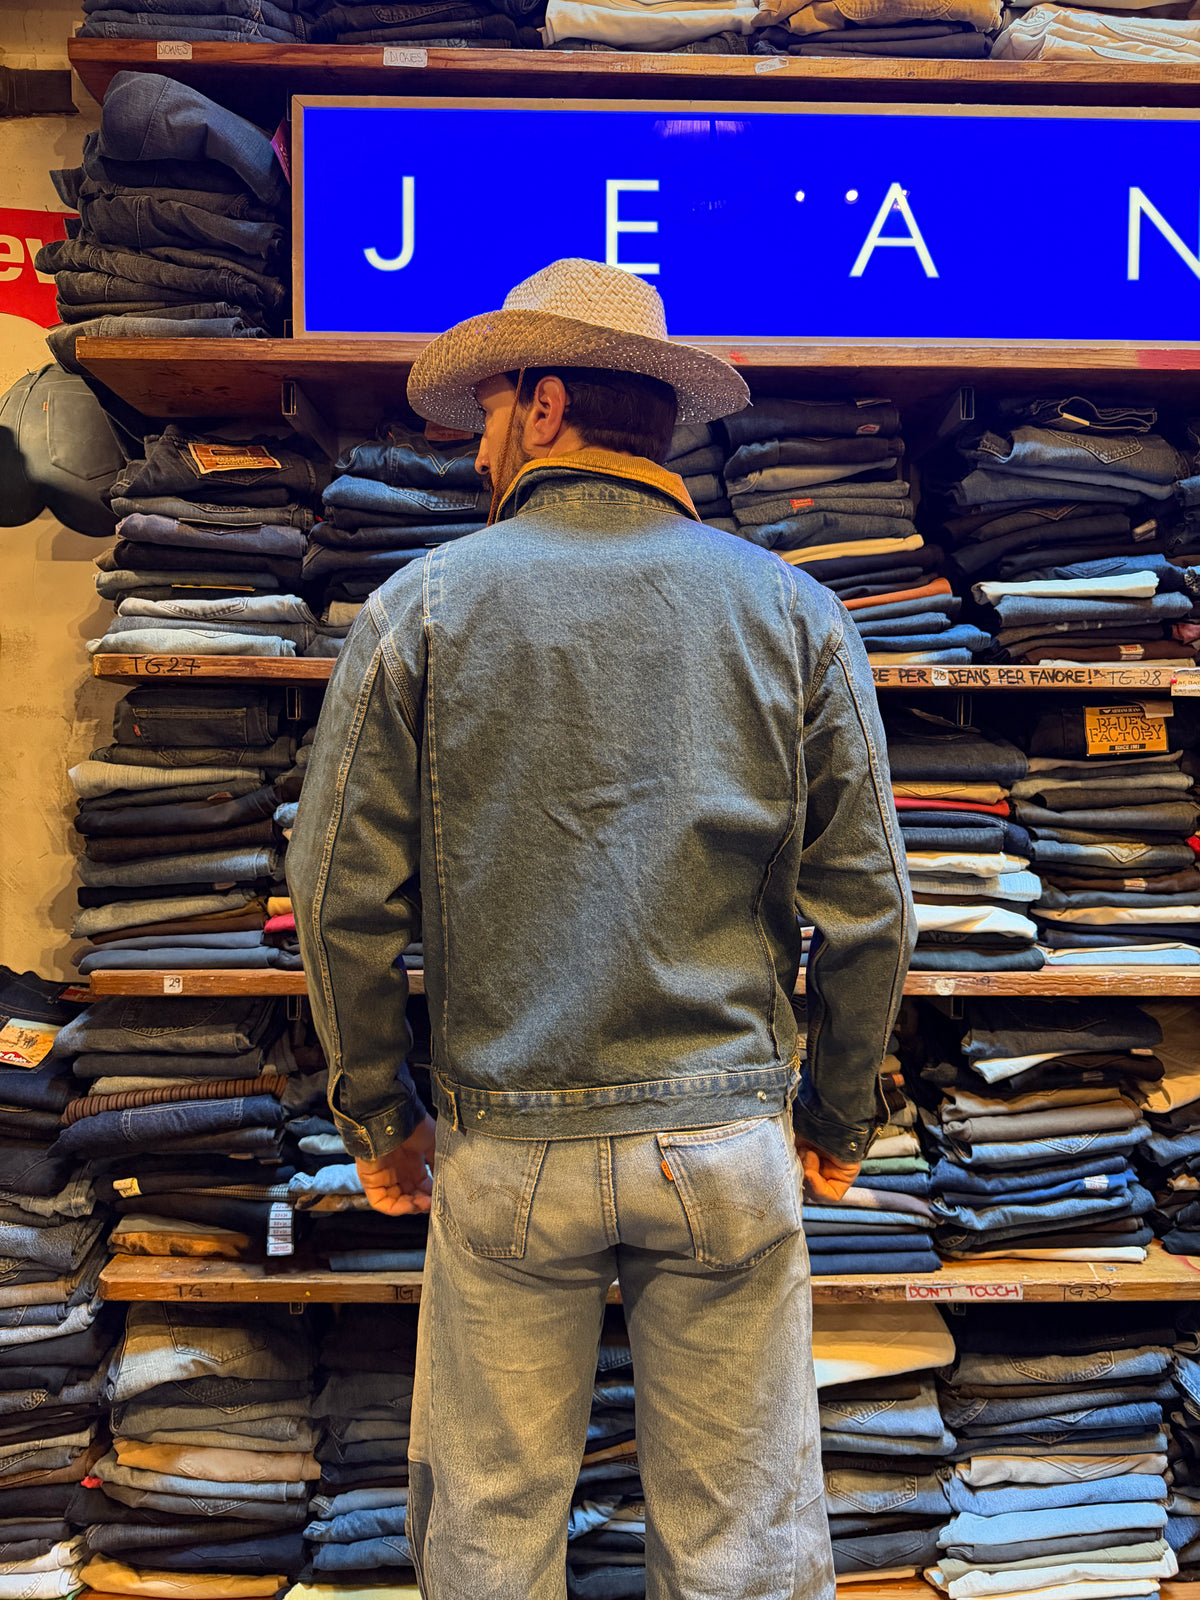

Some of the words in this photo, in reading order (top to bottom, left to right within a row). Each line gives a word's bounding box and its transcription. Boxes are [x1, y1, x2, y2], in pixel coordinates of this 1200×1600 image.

[898, 668, 929, 684] PER
[948, 669, 990, 686] JEANS
[998, 669, 1026, 684] PER
[1029, 669, 1093, 685] FAVORE!
[1089, 725, 1163, 743] FACTORY
[169, 978, 180, 988] 29
[908, 1286, 954, 1298] DON'T
[966, 1285, 1019, 1297] TOUCH
